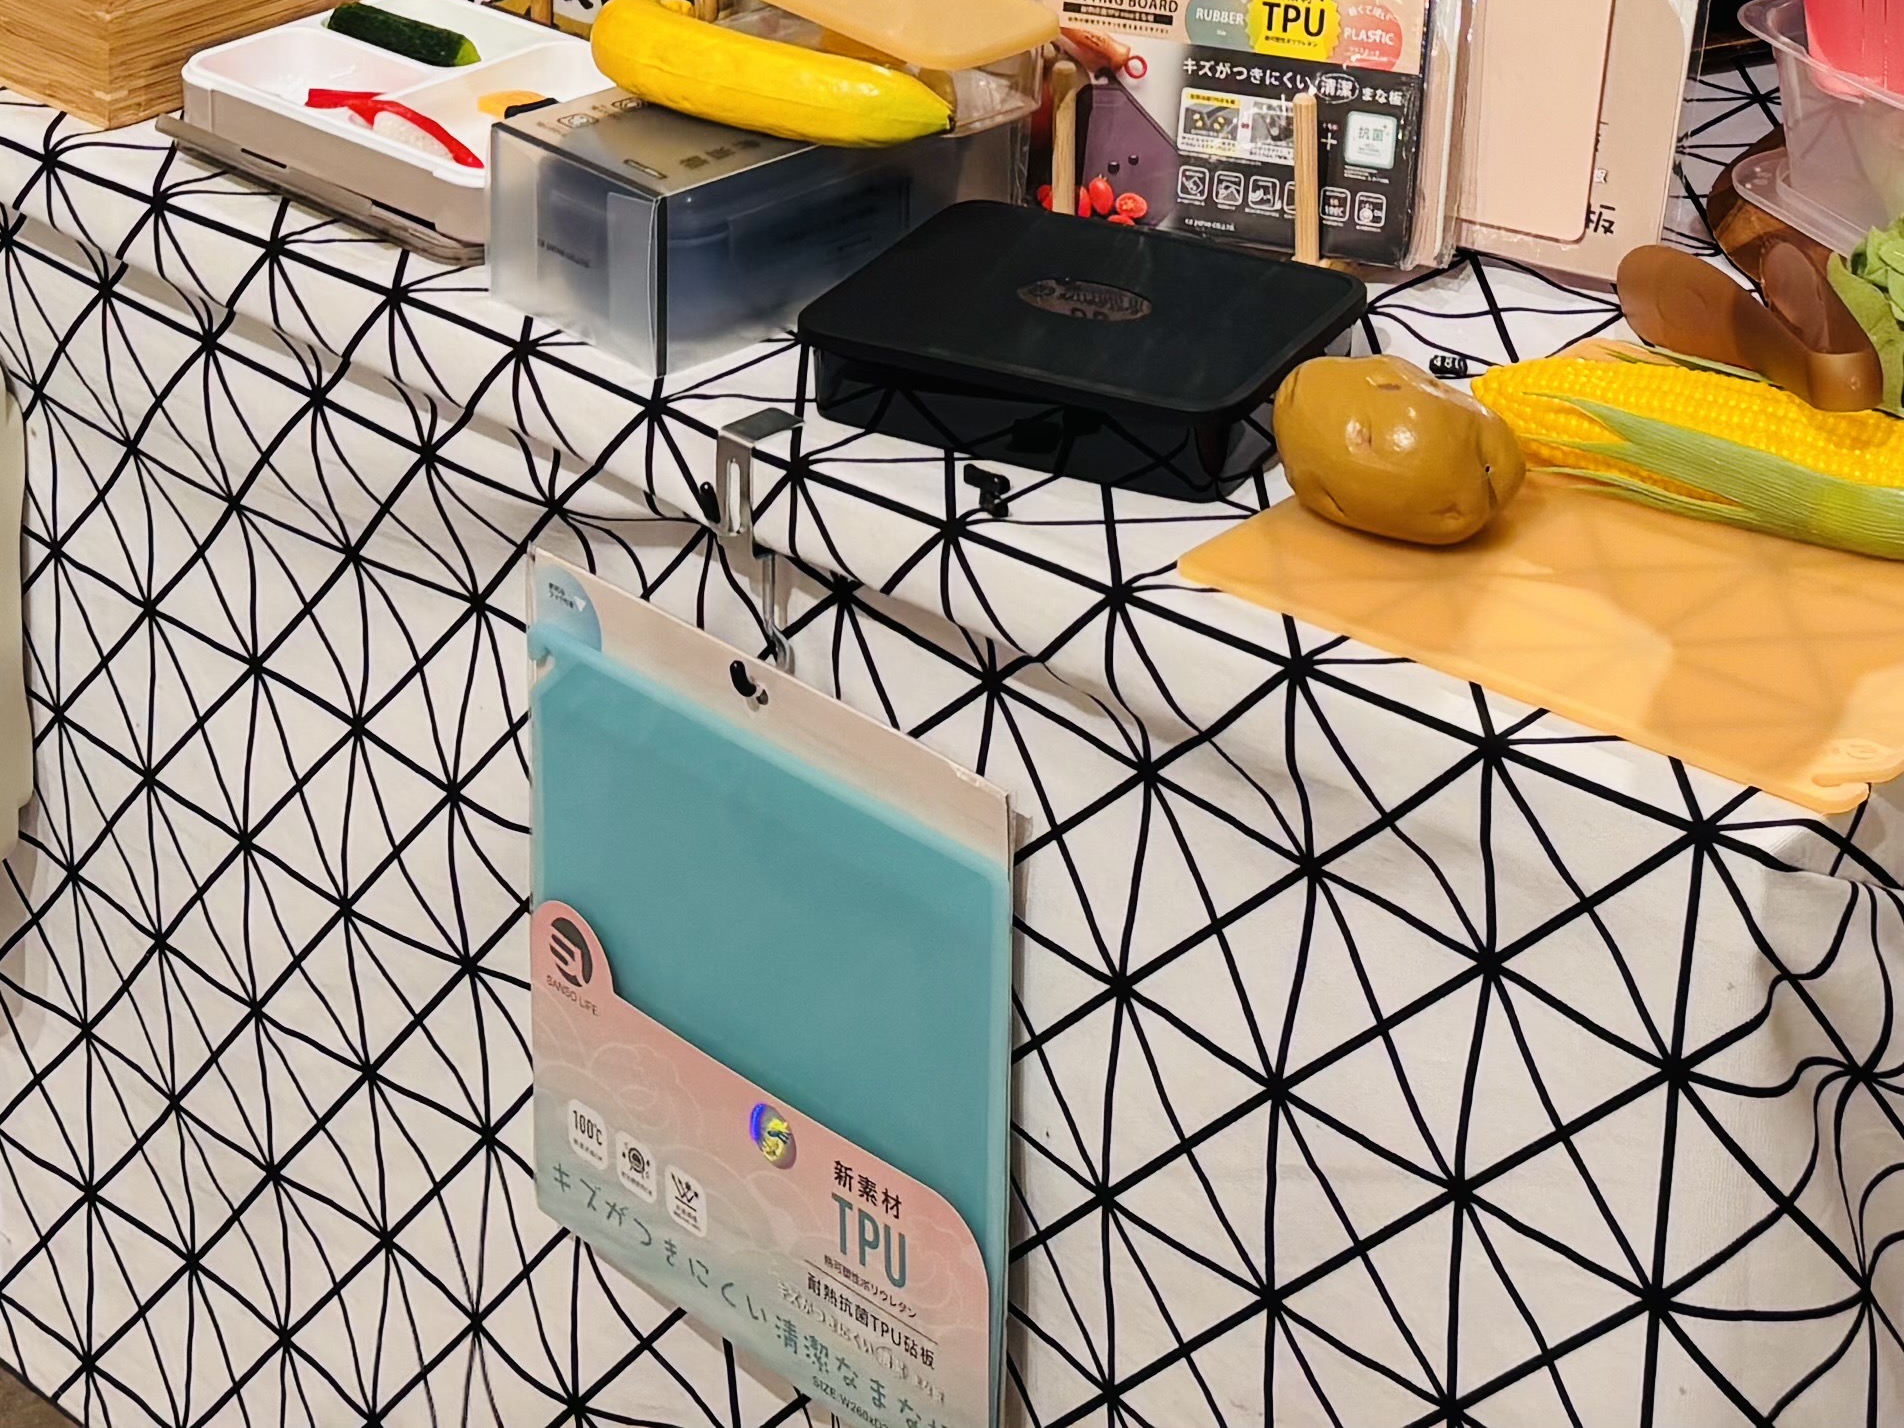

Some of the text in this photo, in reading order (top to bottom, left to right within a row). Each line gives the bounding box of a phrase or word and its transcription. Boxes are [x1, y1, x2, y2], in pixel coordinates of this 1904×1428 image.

[1195, 7, 1245, 27] RUBBER
[1261, 1, 1327, 38] TPU
[1343, 26, 1395, 46] PLASTIC
[1182, 57, 1312, 91] キズがつきにくい
[1356, 128, 1386, 144] 抗菌
[545, 973, 601, 1017] SANSO LIFE
[832, 1158, 903, 1221] 新素材
[830, 1192, 908, 1290] TPU
[806, 1270, 937, 1371] 耐熱抗菌TPU砧板
